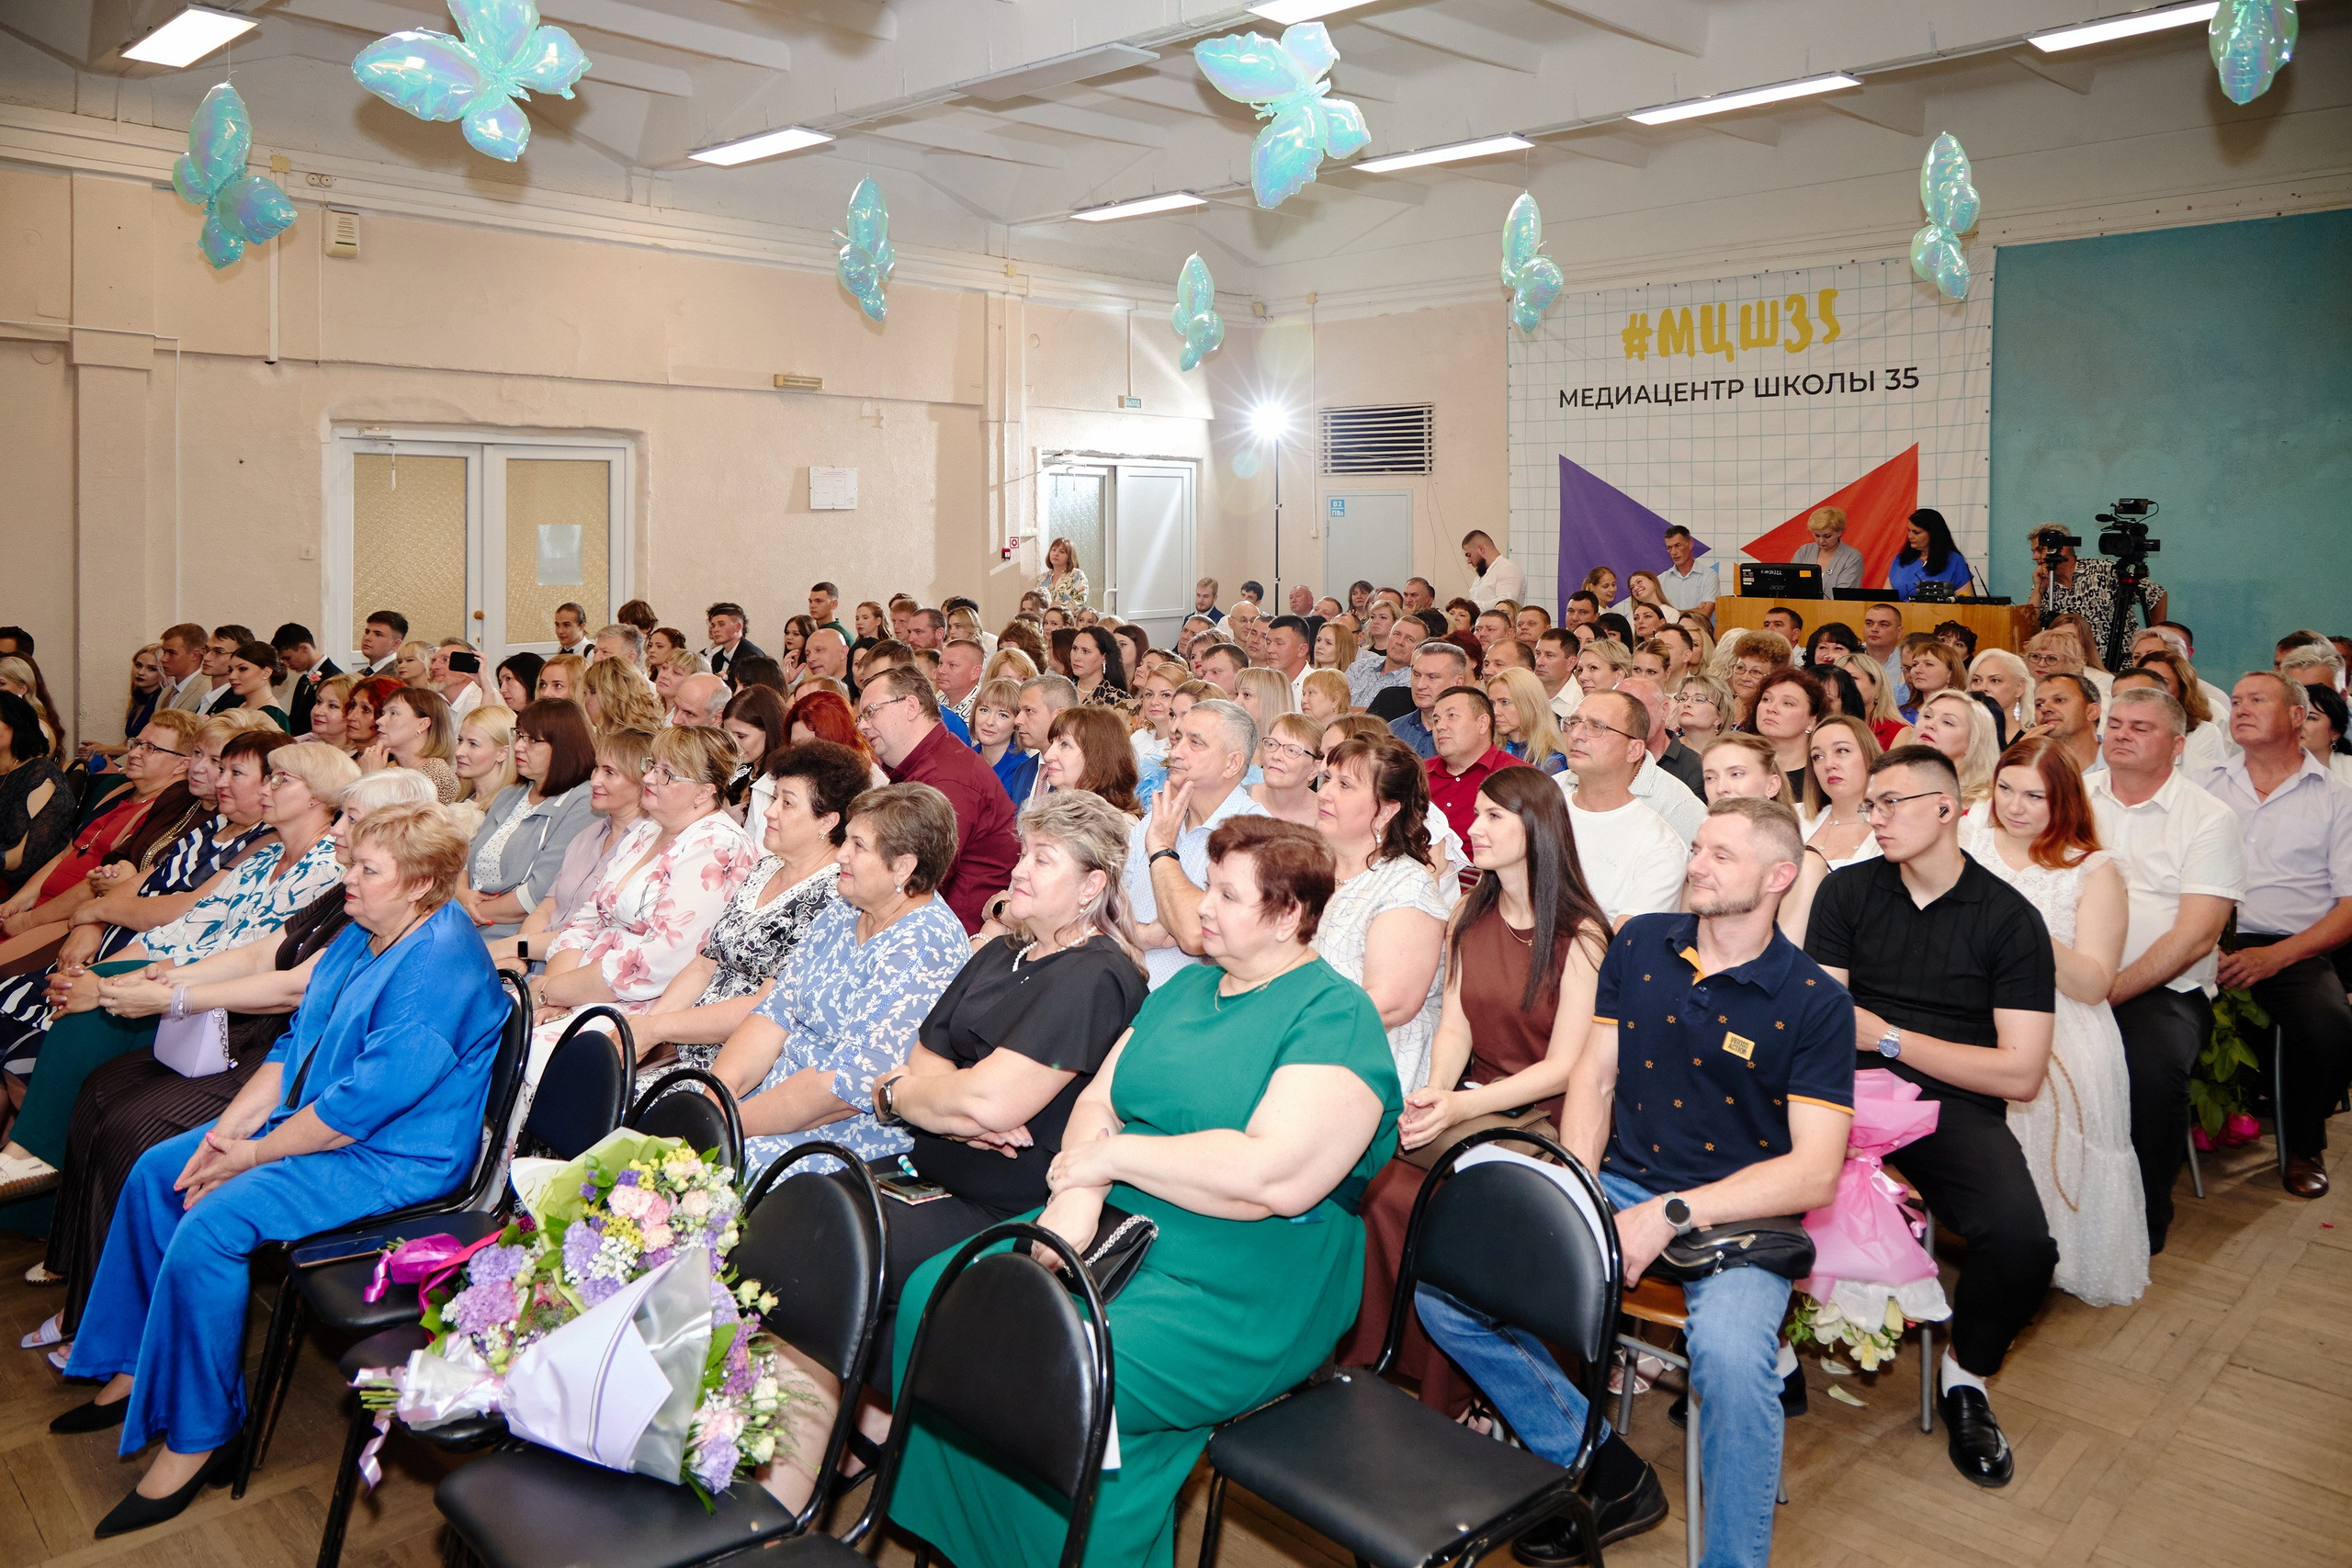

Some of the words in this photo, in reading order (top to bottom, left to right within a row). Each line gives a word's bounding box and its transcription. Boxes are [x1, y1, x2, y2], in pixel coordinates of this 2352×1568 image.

[1622, 288, 1841, 363] #МЦШ35
[1558, 378, 1745, 411] МЕДИАЦЕНТР
[1753, 370, 1875, 399] ШКОЛЫ
[1884, 367, 1920, 391] 35
[1727, 1043, 1747, 1055] ACTION
